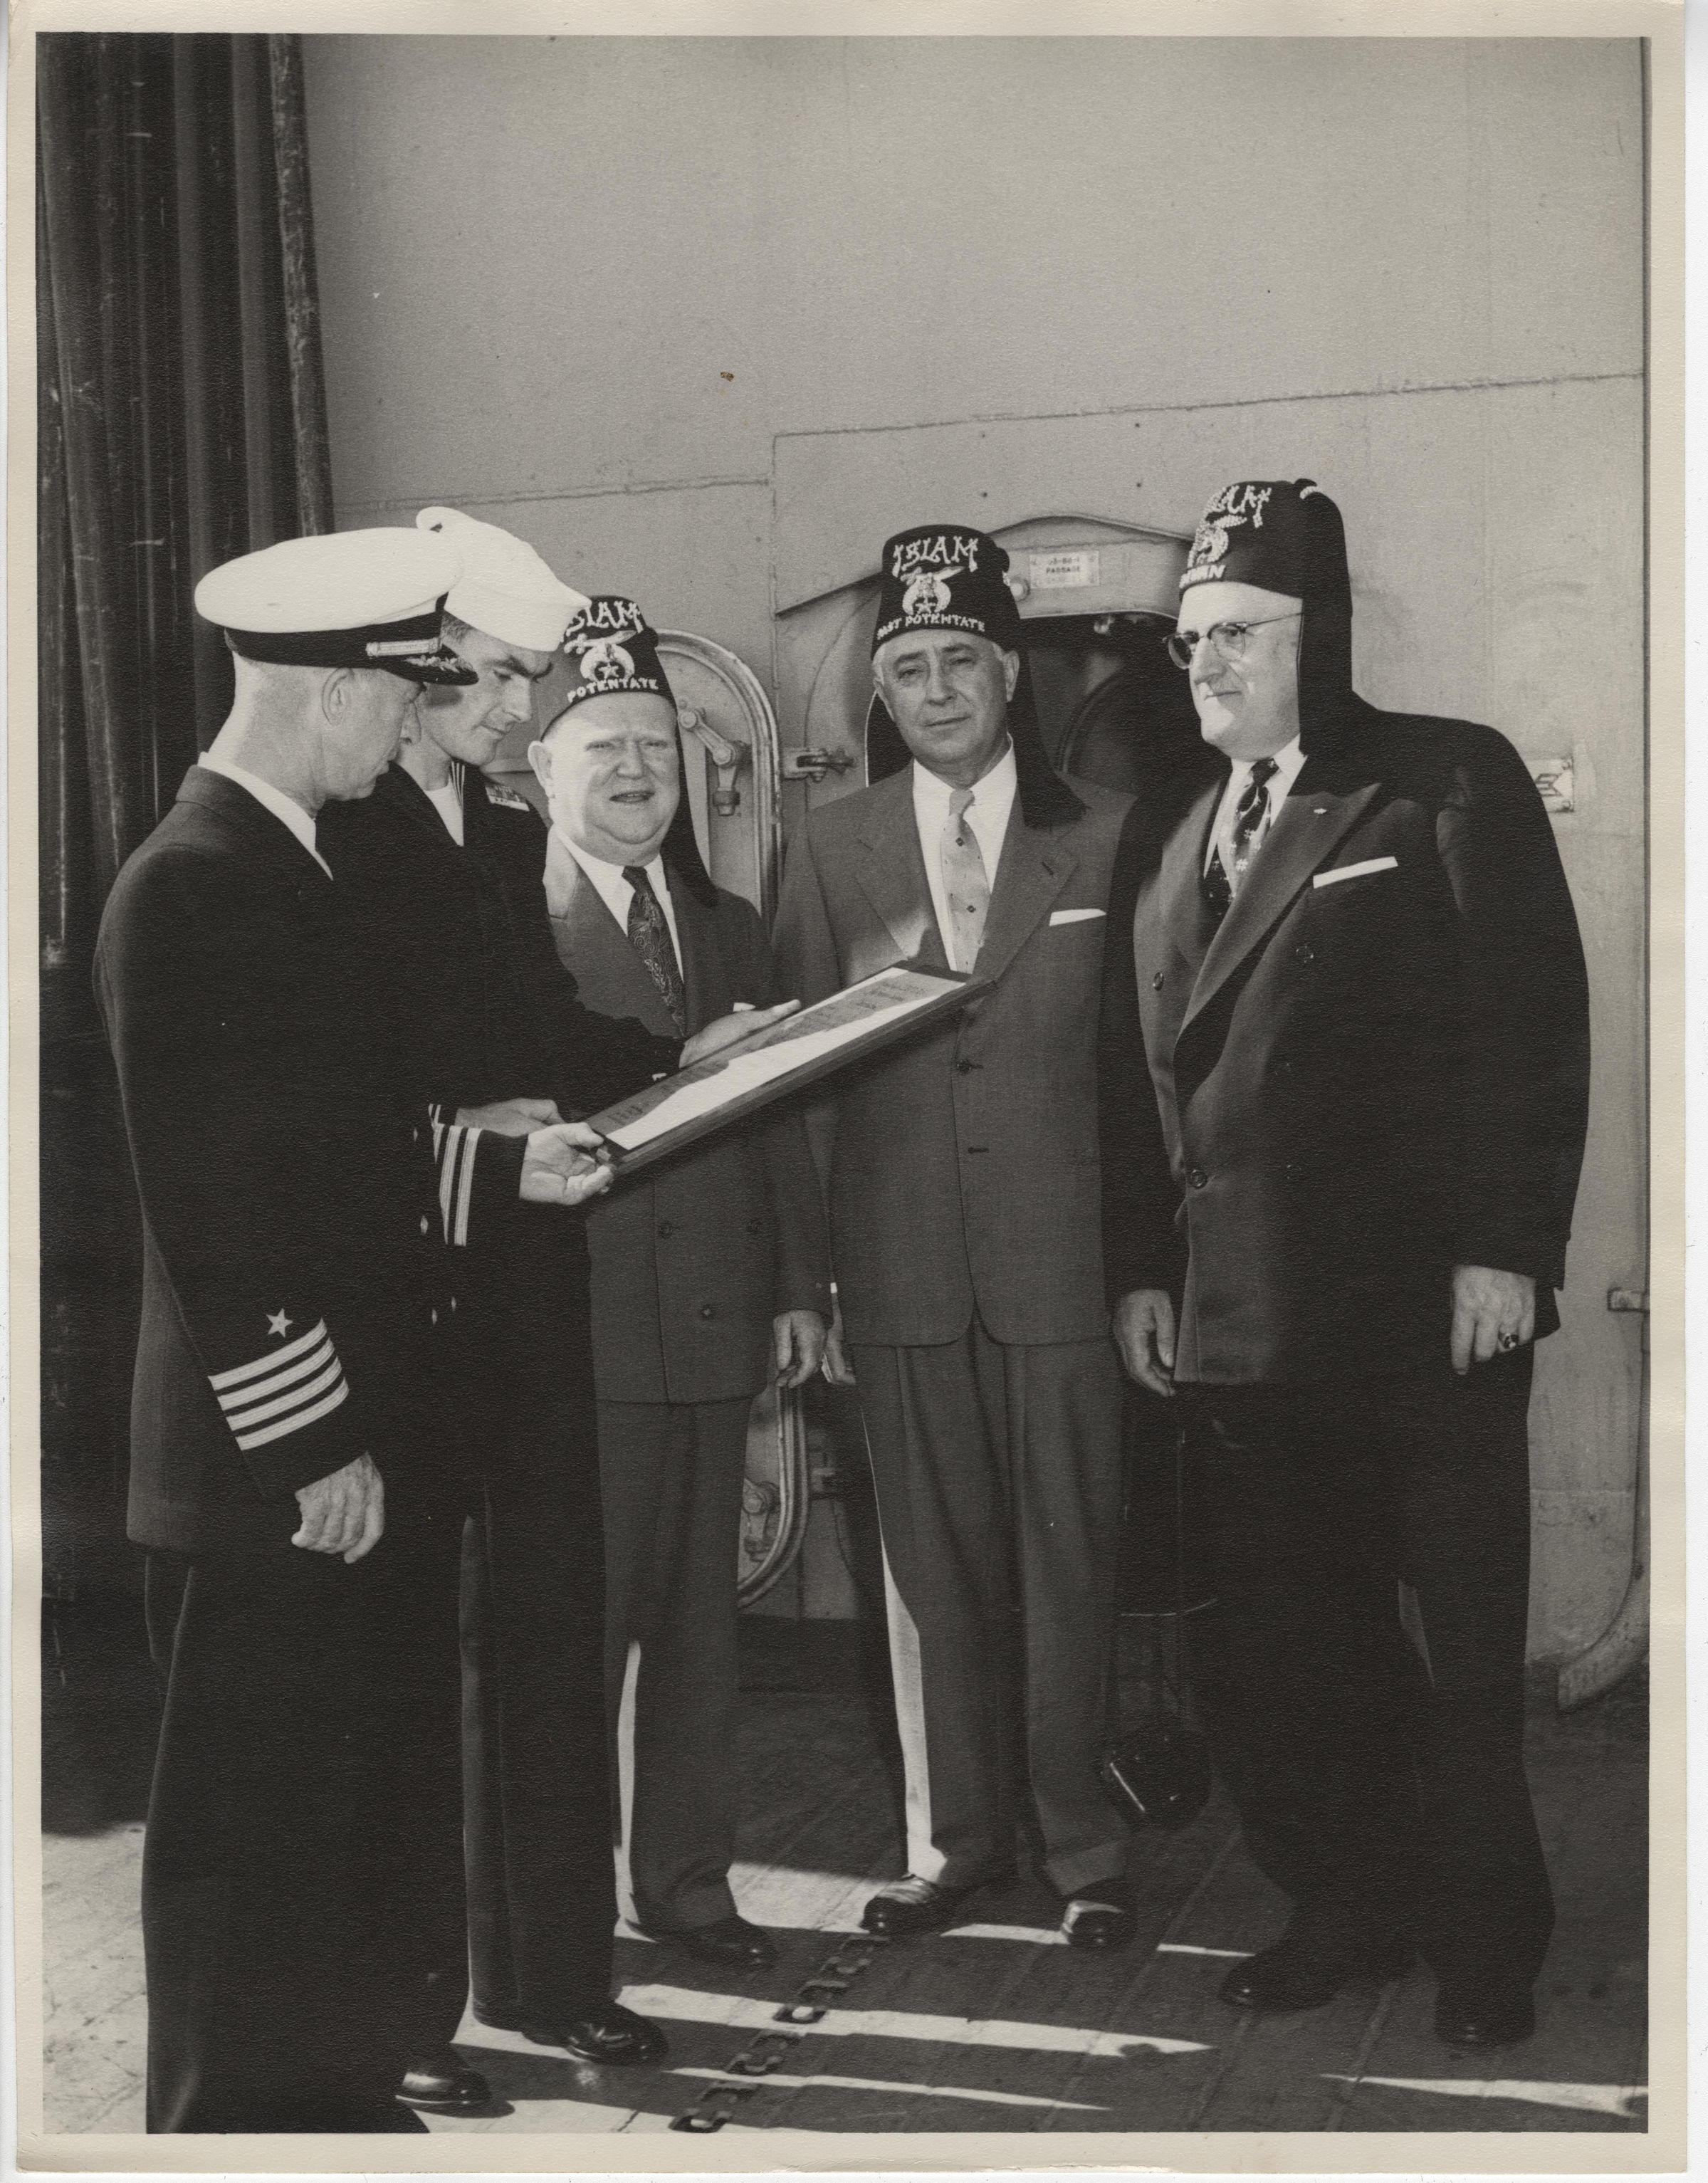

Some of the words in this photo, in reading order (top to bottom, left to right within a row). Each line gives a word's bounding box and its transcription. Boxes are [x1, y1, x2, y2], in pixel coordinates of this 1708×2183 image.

[892, 535, 979, 578] ISLAM
[564, 600, 644, 639] SLAM
[905, 613, 985, 632] POTENTATE
[567, 677, 659, 703] POTENTATE
